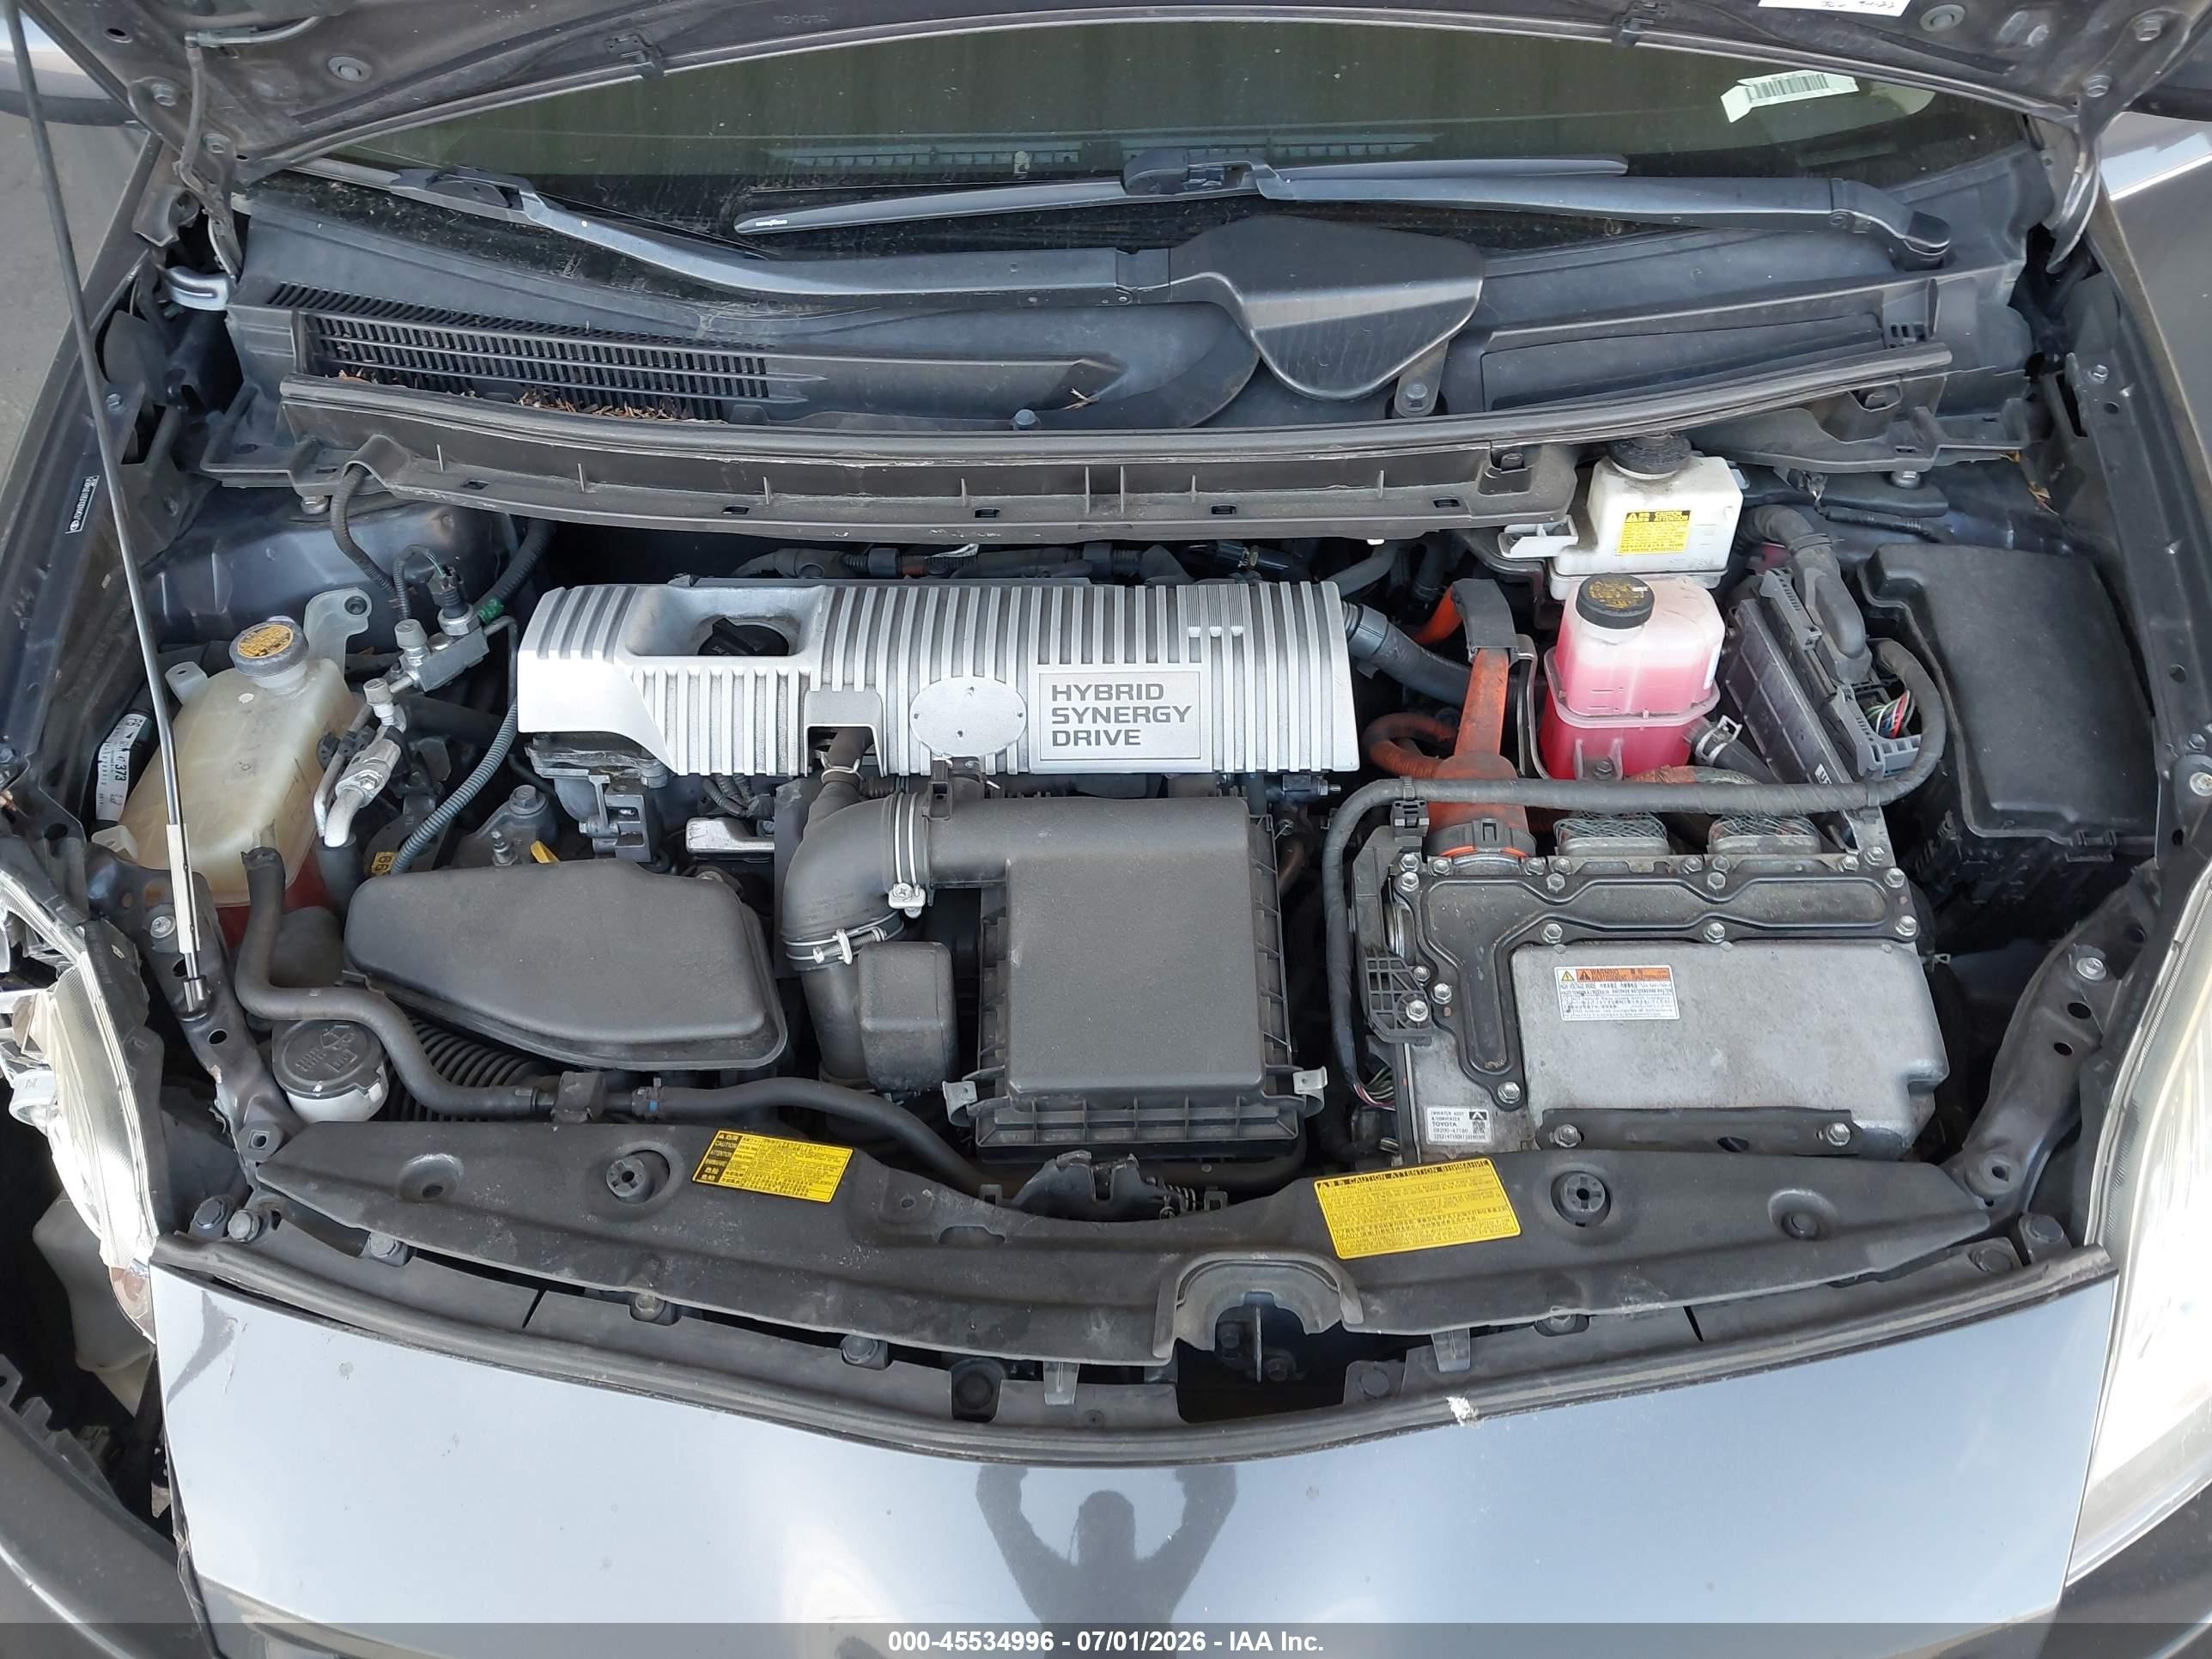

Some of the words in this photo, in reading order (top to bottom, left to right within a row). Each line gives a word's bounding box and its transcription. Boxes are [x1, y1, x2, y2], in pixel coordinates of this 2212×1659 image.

[1052, 684, 1164, 702] HYBRID
[1052, 706, 1192, 724] SYNERGY
[1053, 730, 1141, 747] DRIVE
[115, 764, 127, 781] 373
[714, 1139, 738, 1150] CAUTION
[1351, 1174, 1386, 1185] CAUTION
[1391, 1166, 1439, 1179] ATTENTION
